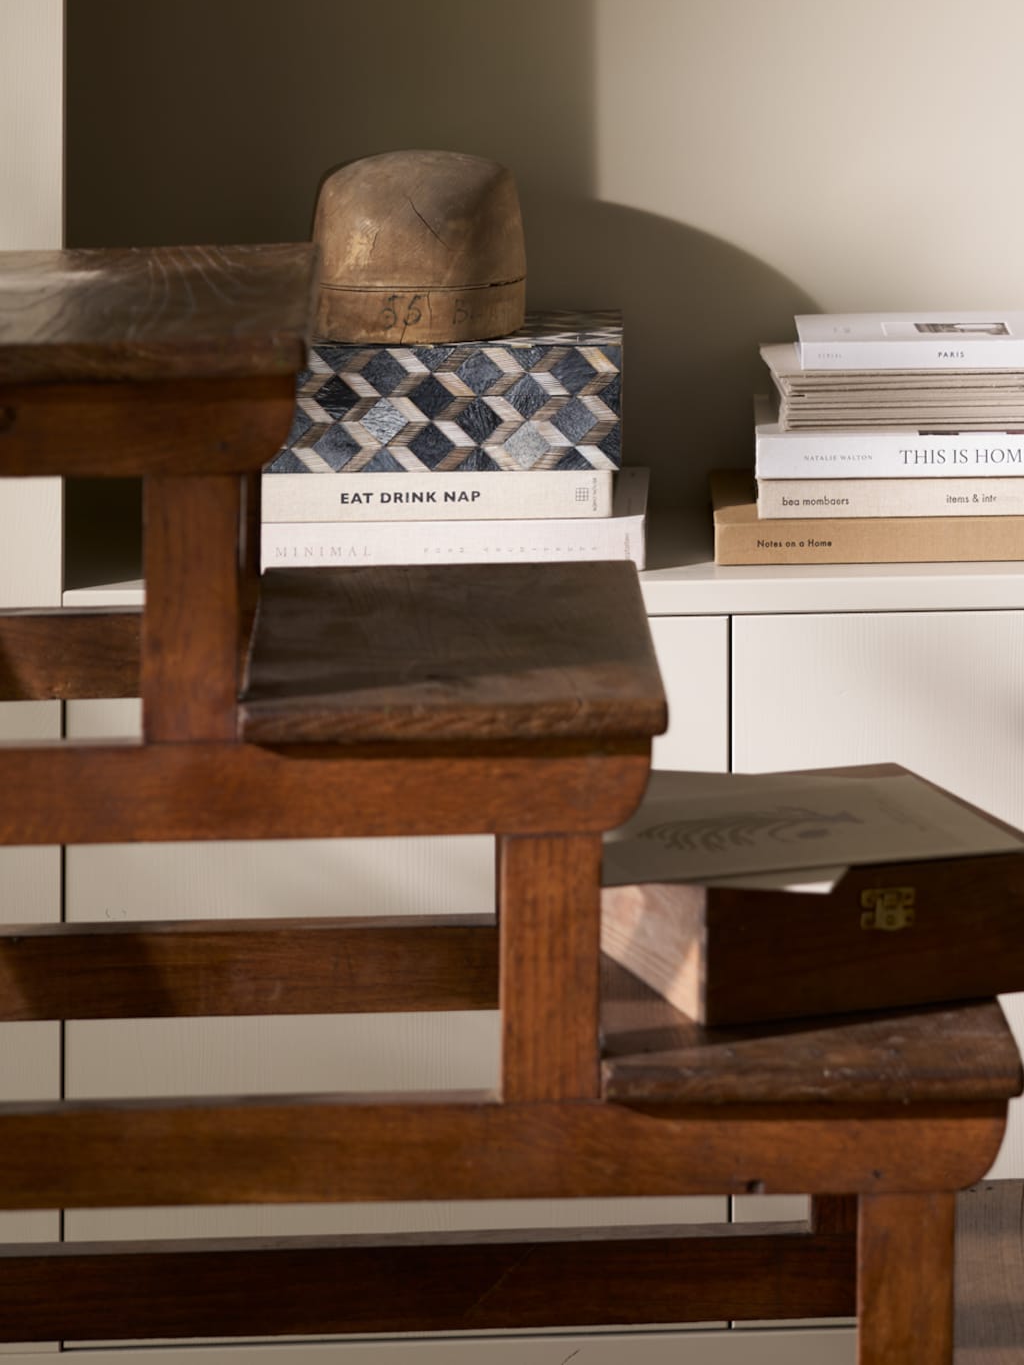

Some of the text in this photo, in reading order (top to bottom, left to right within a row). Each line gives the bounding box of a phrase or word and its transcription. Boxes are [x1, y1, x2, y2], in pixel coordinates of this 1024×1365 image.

[937, 350, 966, 359] PARIS
[803, 453, 874, 462] NATALIE WALTON
[898, 448, 947, 465] THIS
[952, 448, 970, 465] IS
[340, 490, 482, 505] EAT DRINK NAP
[781, 495, 800, 507] bea
[945, 494, 970, 504] items
[972, 493, 980, 504] &
[756, 538, 833, 548] Notes on a Home
[274, 545, 374, 559] MINIMAL
